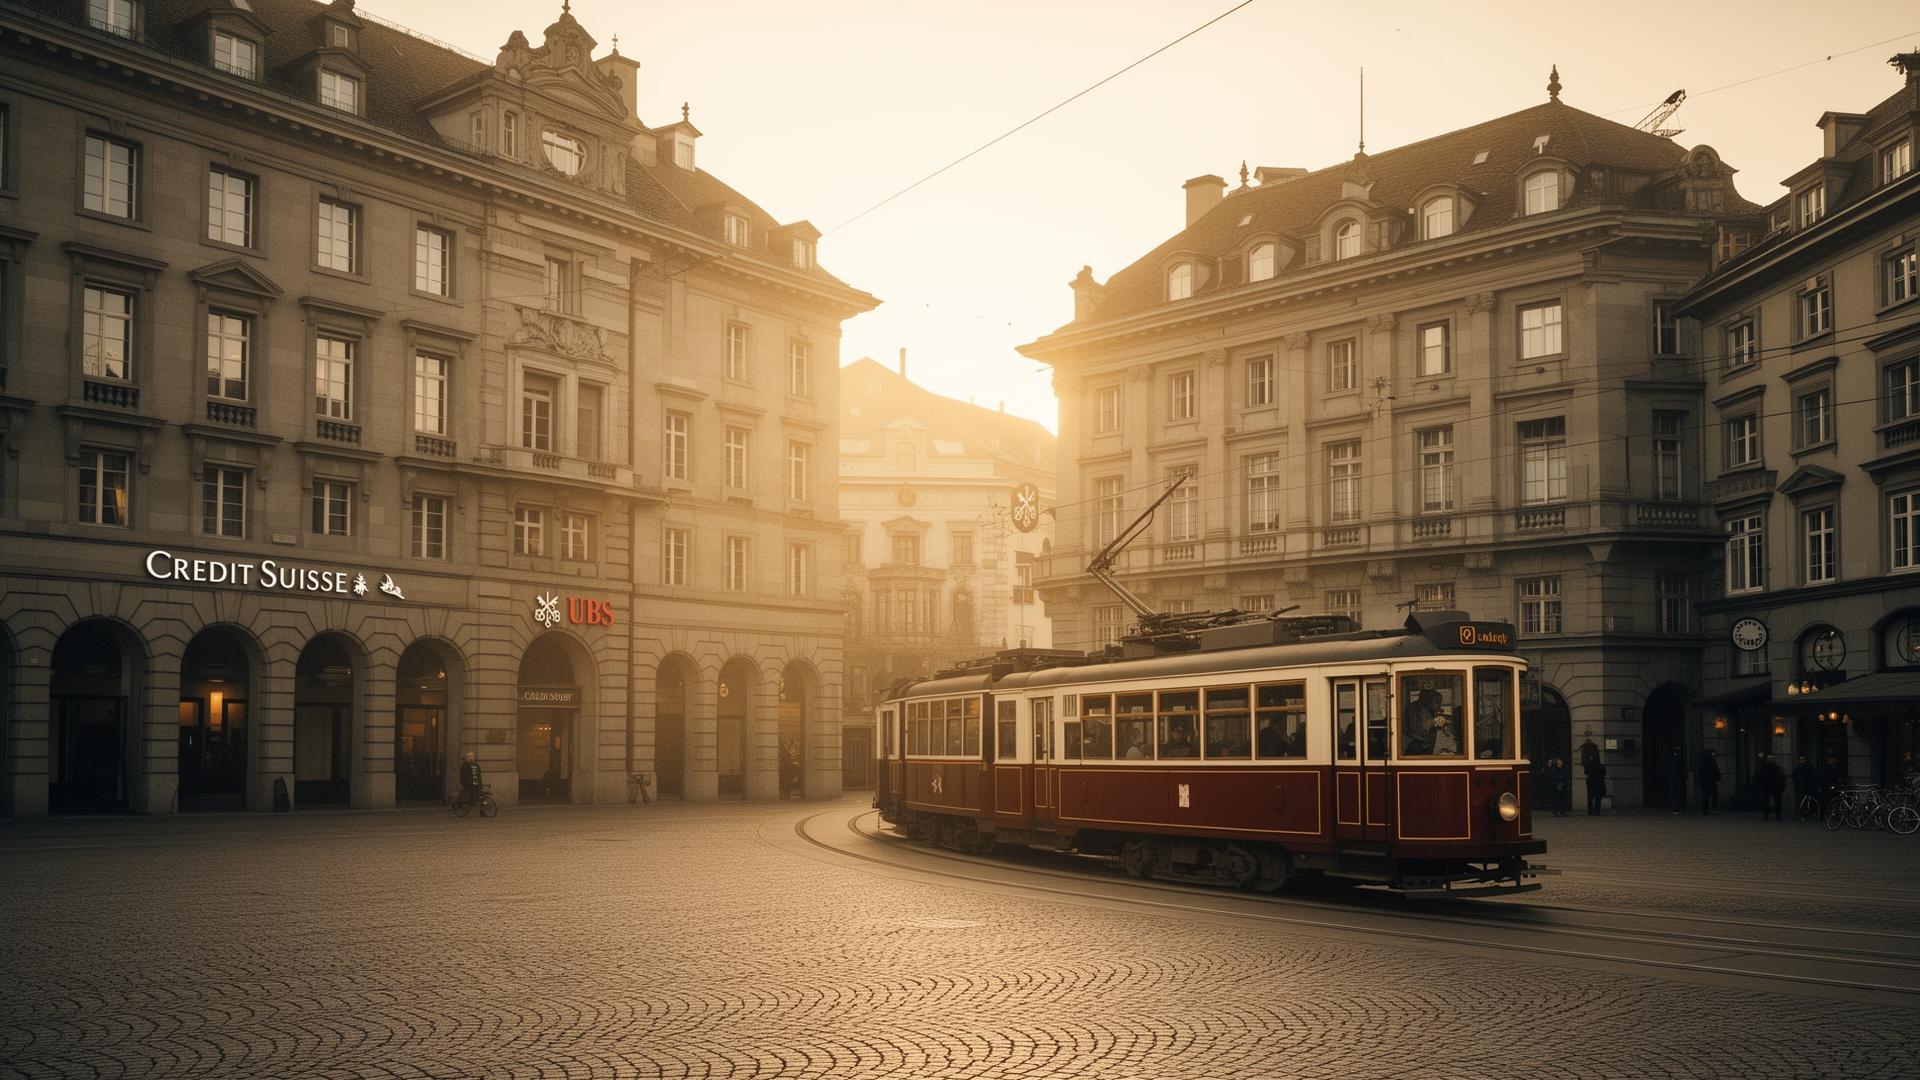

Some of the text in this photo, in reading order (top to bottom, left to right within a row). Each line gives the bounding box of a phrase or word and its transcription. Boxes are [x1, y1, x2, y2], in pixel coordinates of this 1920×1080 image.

[146, 550, 348, 594] CREDIT SUISSE
[568, 596, 615, 626] UBS
